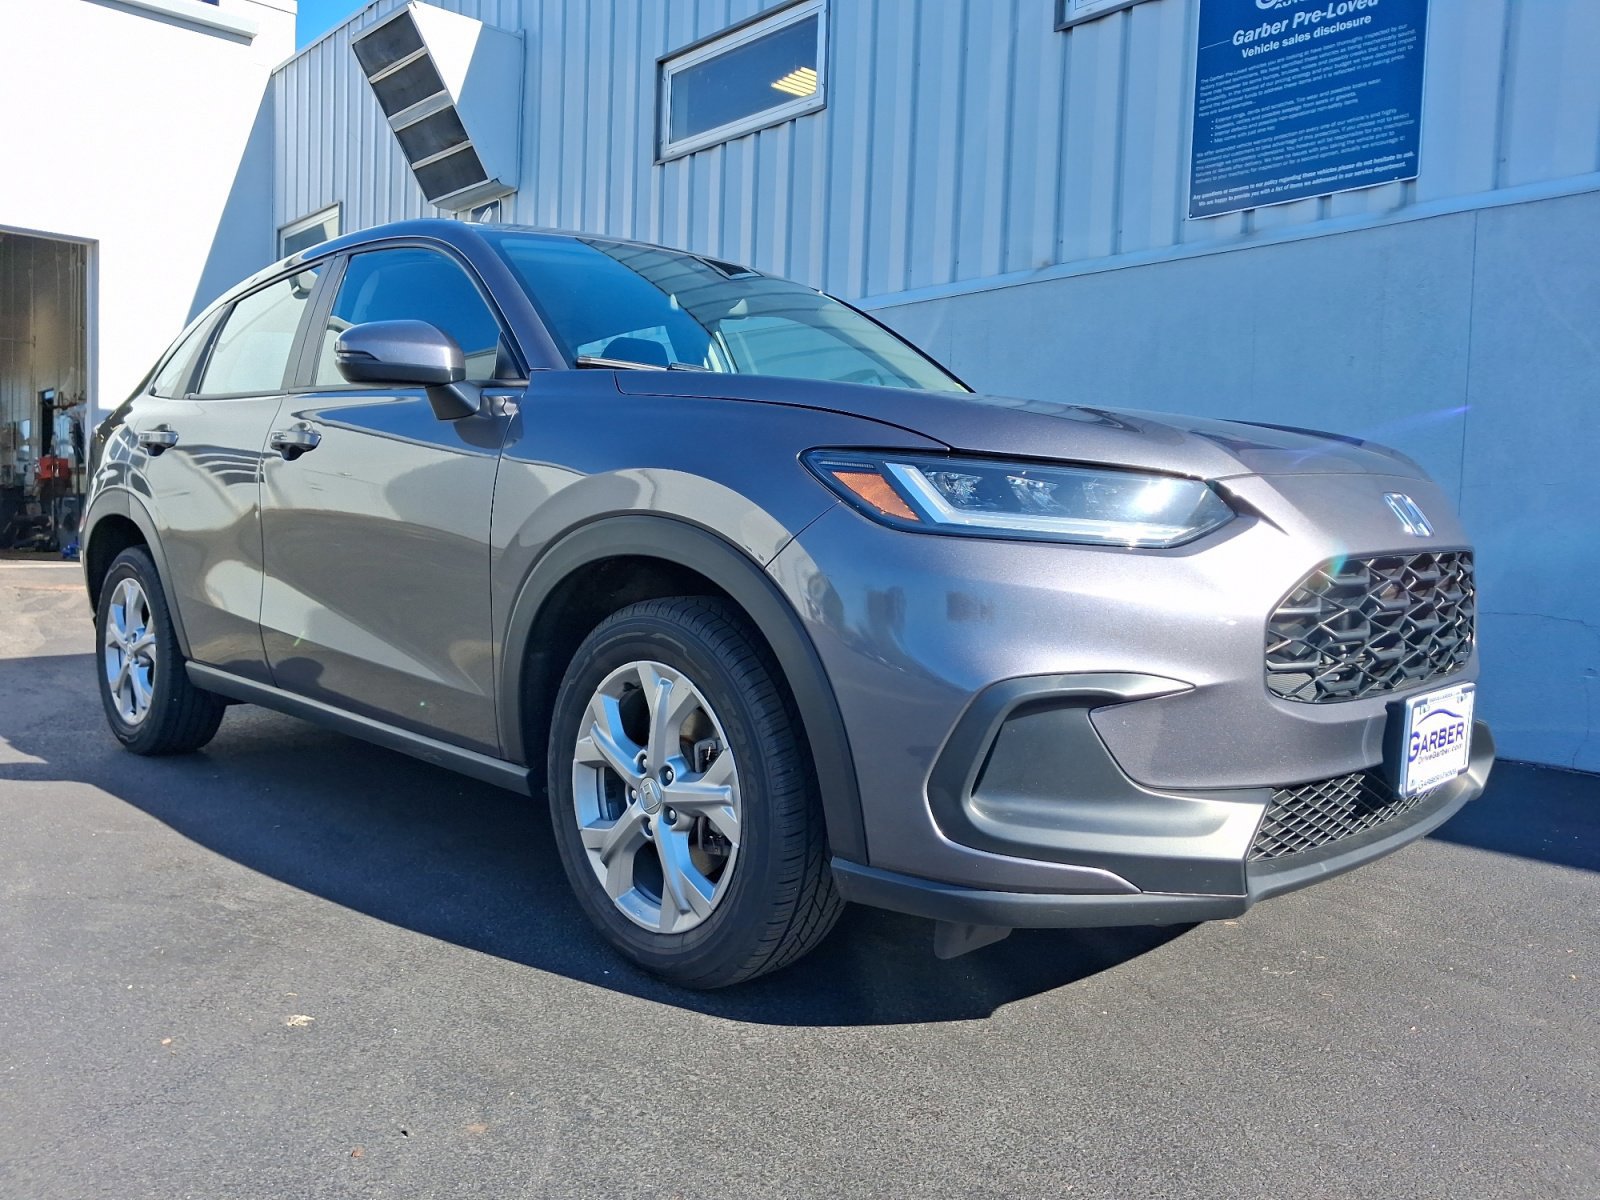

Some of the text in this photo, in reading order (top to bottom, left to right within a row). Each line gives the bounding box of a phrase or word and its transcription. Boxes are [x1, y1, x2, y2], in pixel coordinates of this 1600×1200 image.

[1233, 0, 1379, 46] Garber Pre-Loved
[1242, 15, 1372, 58] Vehicle sales disclosure
[1408, 722, 1464, 763] GARBER
